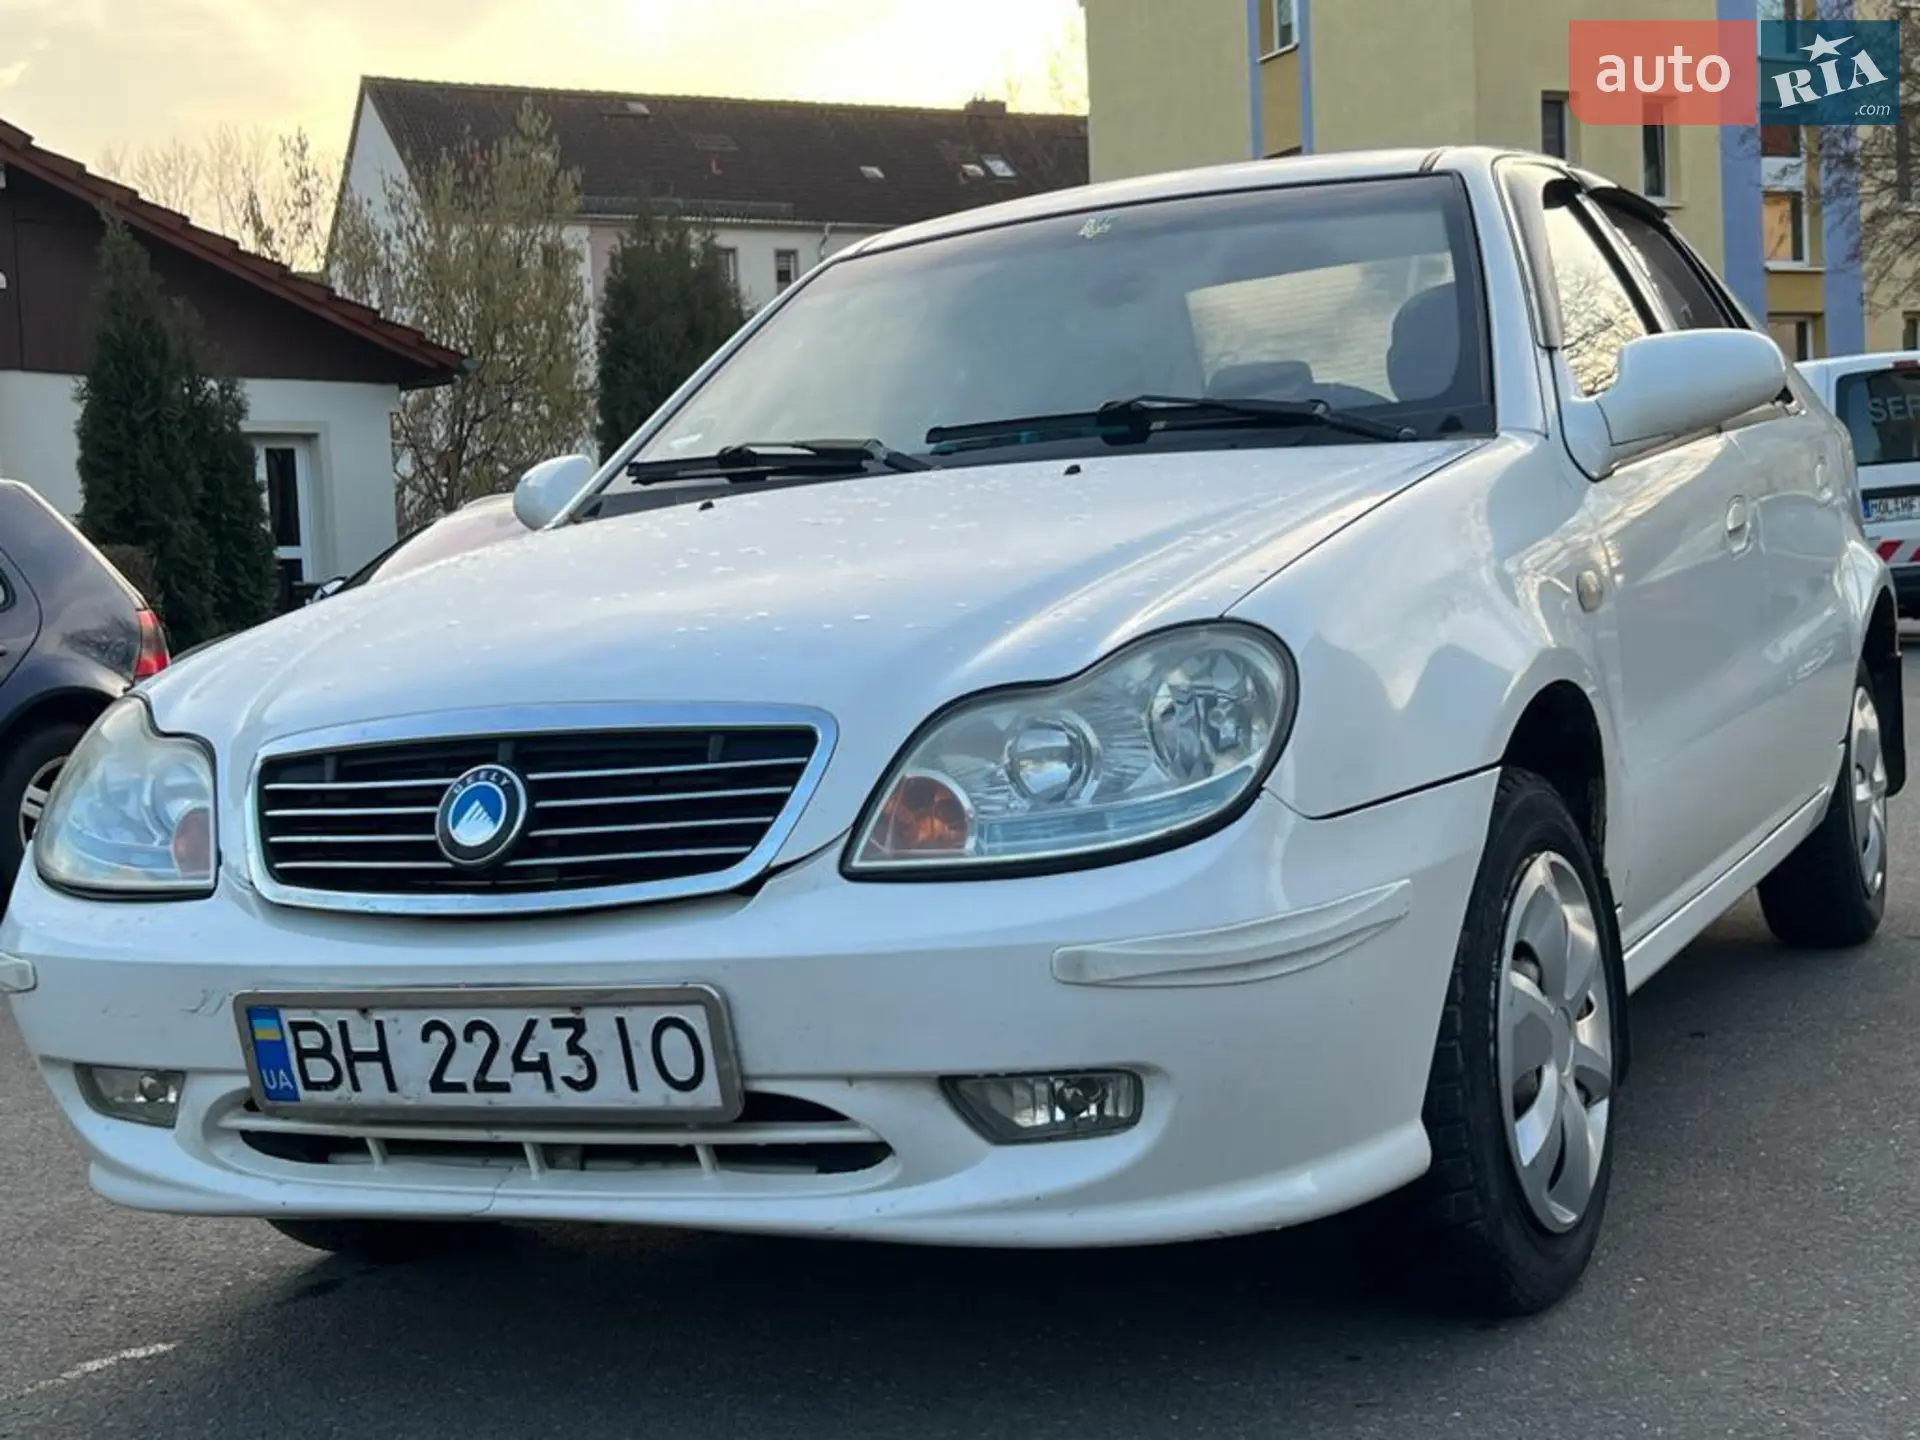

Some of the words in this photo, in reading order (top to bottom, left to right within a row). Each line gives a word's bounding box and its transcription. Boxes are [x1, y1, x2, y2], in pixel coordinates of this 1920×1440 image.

[261, 1067, 294, 1091] UA
[287, 1019, 399, 1093] BH
[420, 1016, 598, 1094] 2243
[615, 1015, 705, 1093] IO
